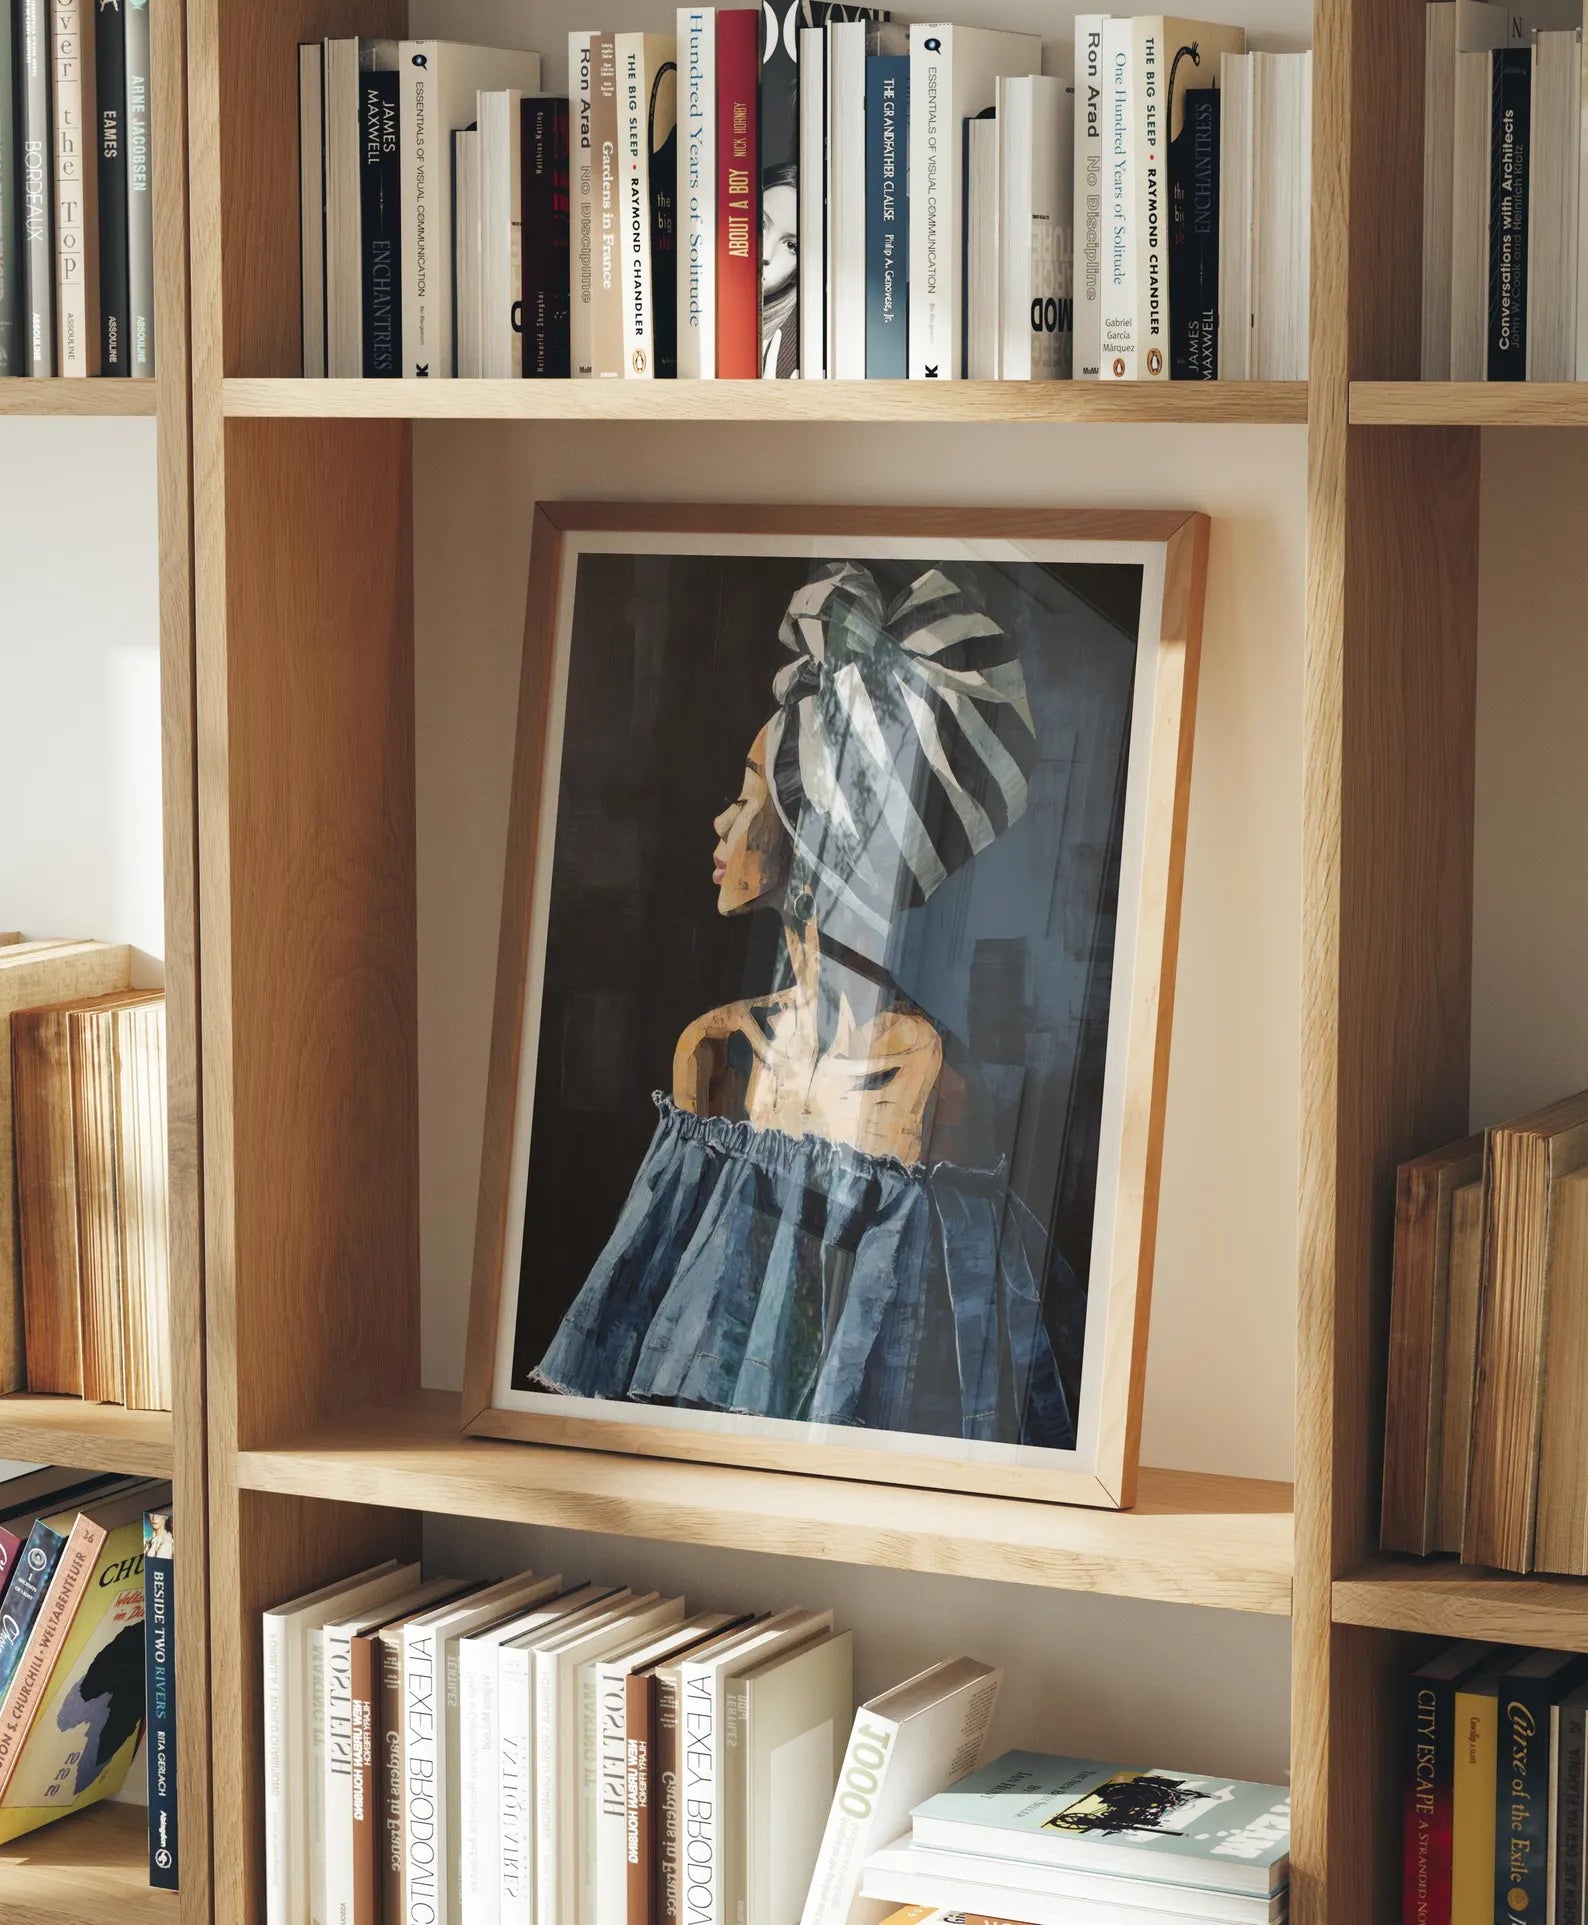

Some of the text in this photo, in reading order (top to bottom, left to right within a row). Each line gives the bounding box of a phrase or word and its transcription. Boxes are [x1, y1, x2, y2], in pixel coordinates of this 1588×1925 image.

[61, 109, 75, 176] the
[103, 111, 117, 158] EAMES
[131, 75, 146, 192] ARNE JACOBSEN
[367, 90, 380, 165] MAXWELL
[383, 101, 395, 152] JAMES
[734, 103, 746, 157] NICK HORNBY
[883, 79, 894, 221] THE GRANDFATHER CLAUSE
[1085, 32, 1100, 301] Ron Arad No Discipline
[25, 141, 43, 242] BORDEAUX
[416, 81, 427, 297] ESSENTIALS OF VISUAL COMMUNICATION
[578, 49, 591, 303] Ron Arad No Discipline
[627, 54, 643, 335] THE BIG SLEEP RAYMOND CHANDLER
[658, 191, 671, 207] the
[689, 14, 703, 327] Hundred Years of Solitude
[927, 67, 937, 293] ESSENTIALS OF VISUAL COMMUNICATION
[1113, 53, 1127, 284] One Hundred Years of Solitude
[1146, 38, 1160, 335] THE BIG SLEEP RAYMOND CHANDLER
[1195, 103, 1213, 234] ENCHANTRESS
[602, 141, 614, 289] Gardens in France
[729, 169, 749, 257] ABOUT A BOY
[1499, 110, 1514, 349] Conversations with Architects
[1512, 145, 1524, 348] John and Heinrich Klotz
[885, 259, 894, 268] A.
[32, 313, 42, 361] ASSOULINE
[66, 312, 76, 360] ASSOULINE
[108, 316, 117, 363] ASSOULINE
[136, 315, 146, 363] ASSOULINE
[373, 240, 392, 370] ENCHANTRESS
[536, 291, 545, 327] Shanghai
[884, 314, 894, 323] Jr.
[1106, 319, 1132, 327] Gabriel
[1107, 331, 1130, 339] García
[1202, 309, 1213, 380] MAXWELL
[1103, 344, 1134, 352] Márquez
[1189, 321, 1199, 372] JAMES
[84, 1531, 94, 1543] 36
[10, 1552, 87, 1733] S. CHURCHILL WELTABENTEUER
[154, 1572, 166, 1719] BESIDE TWO RIVERS
[157, 1731, 167, 1797] RITA GERLACH
[1416, 1689, 1436, 1814] CITY ESCAPE
[1507, 1702, 1535, 1882] Curse of the Exile
[159, 1811, 167, 1847] Abingdon
[1418, 1820, 1430, 1902] A STRANDED
